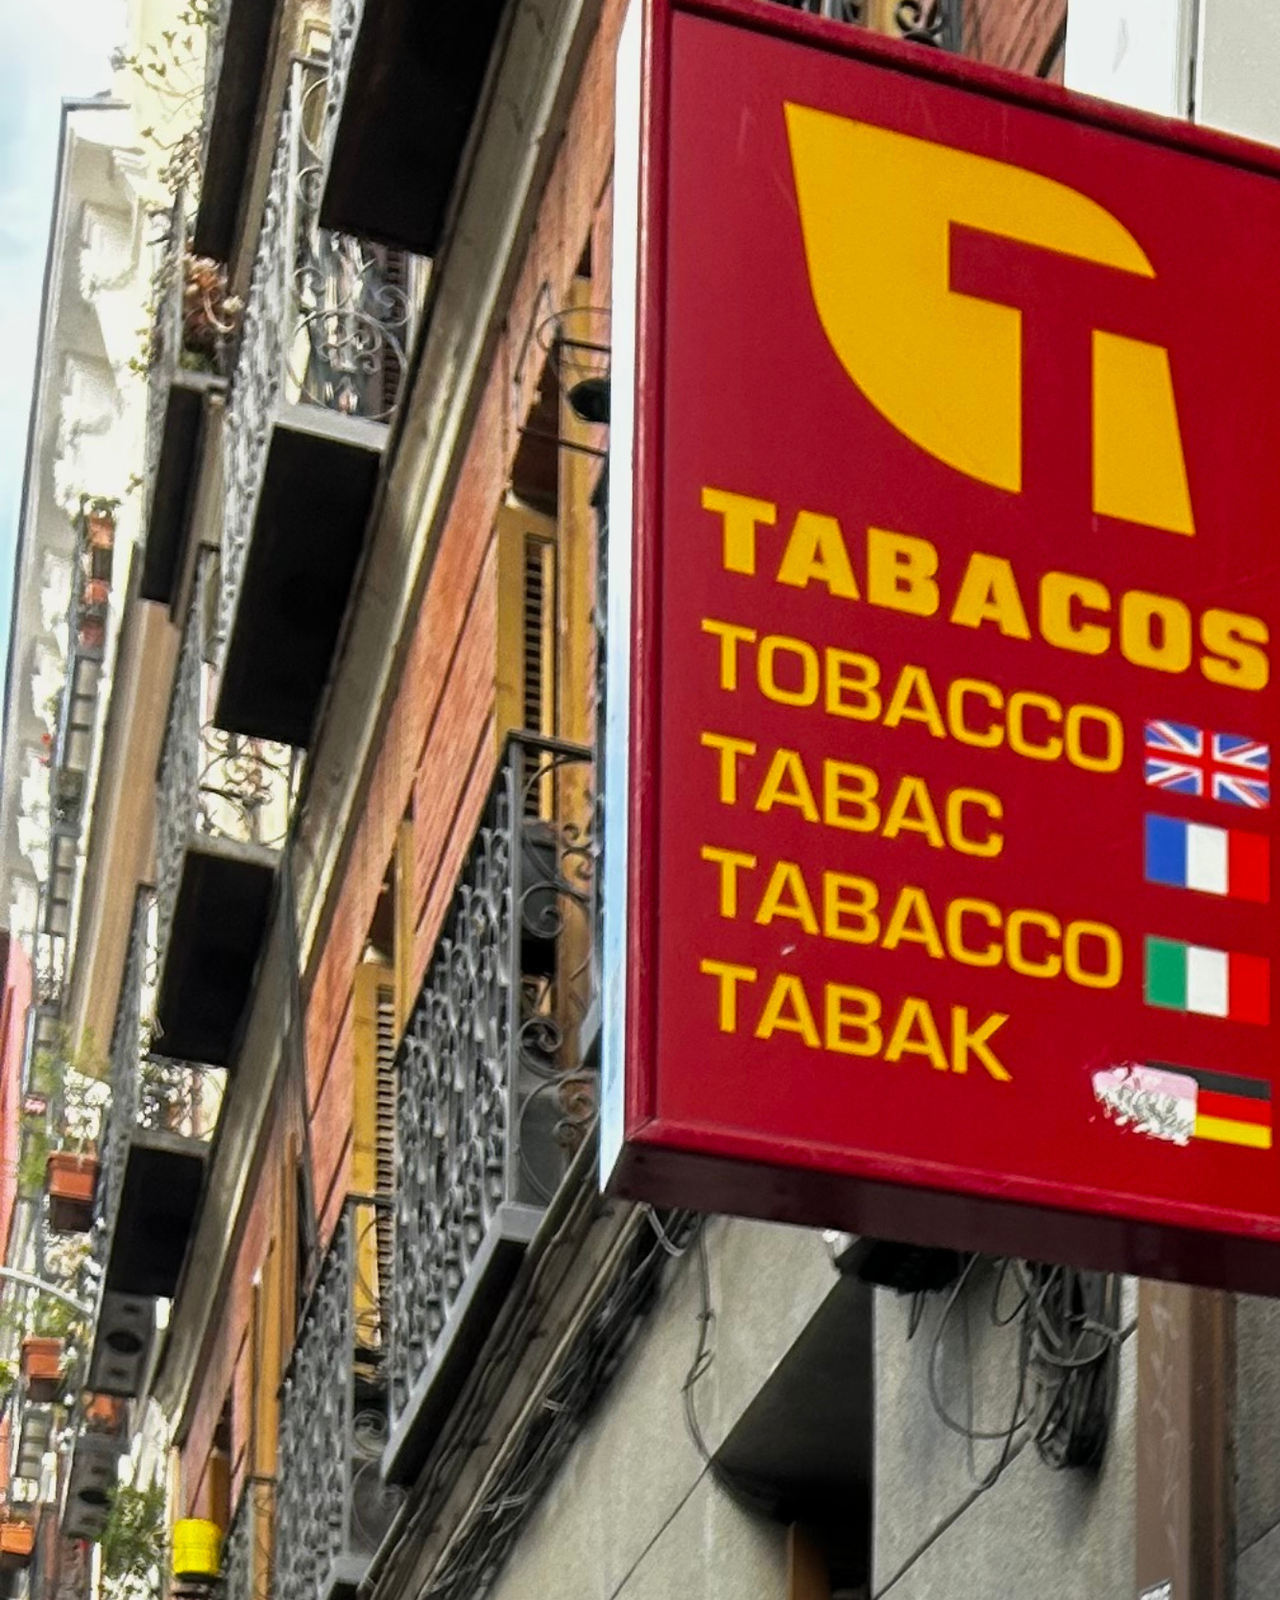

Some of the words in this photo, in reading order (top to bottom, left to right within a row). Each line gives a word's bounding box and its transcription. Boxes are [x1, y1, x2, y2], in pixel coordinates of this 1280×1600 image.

[702, 486, 1270, 691] TABACOS
[701, 619, 1125, 773] TOBACCO
[701, 732, 1005, 858] TABAC
[701, 846, 1123, 990] TABACCO
[701, 959, 1013, 1083] TABAK
